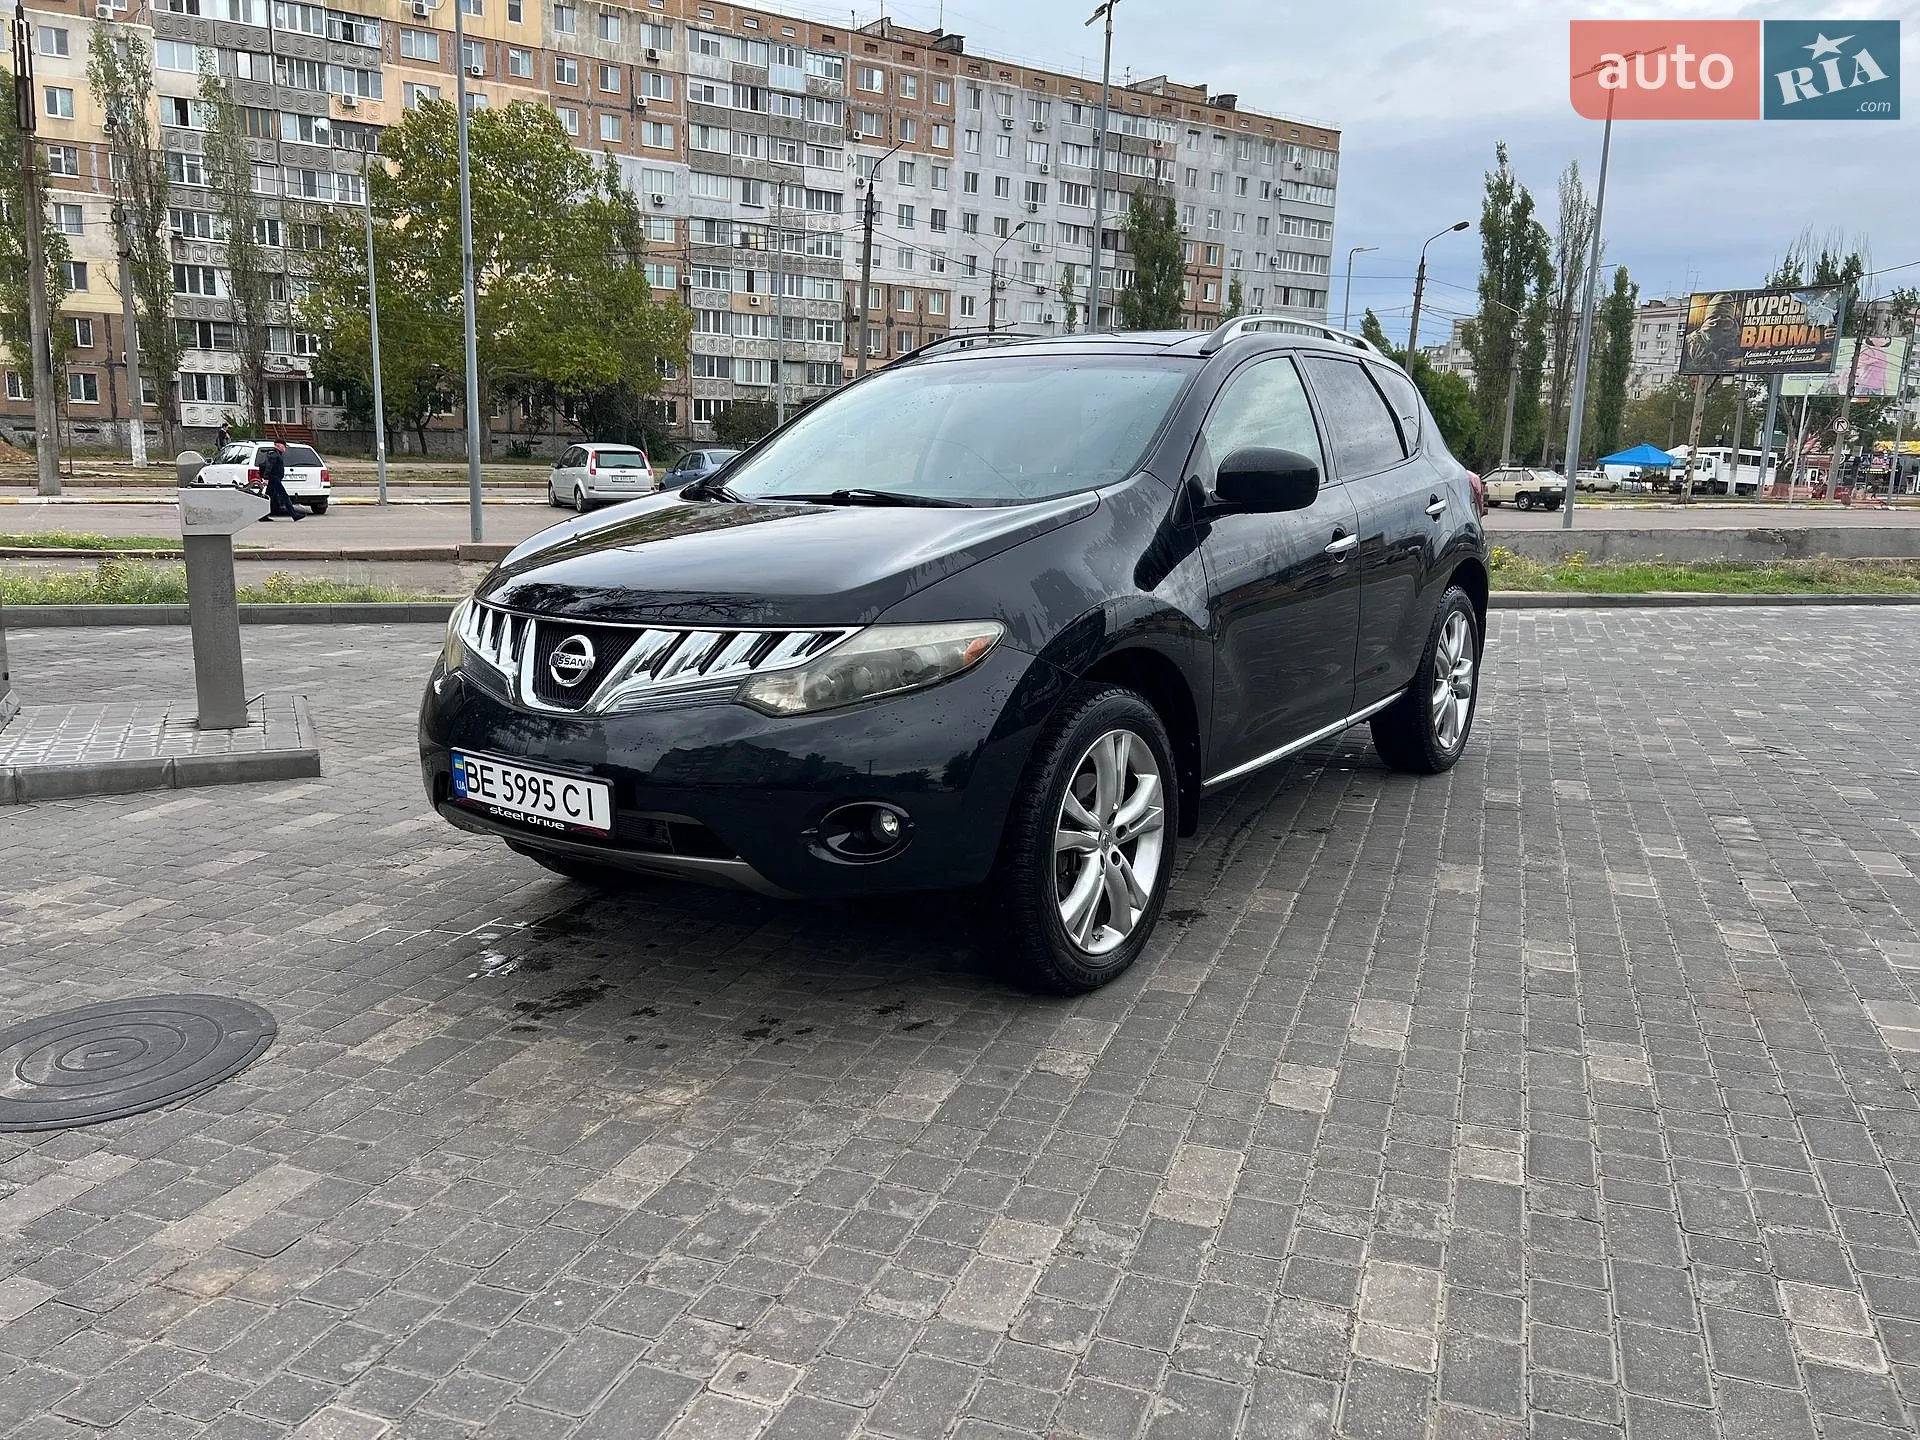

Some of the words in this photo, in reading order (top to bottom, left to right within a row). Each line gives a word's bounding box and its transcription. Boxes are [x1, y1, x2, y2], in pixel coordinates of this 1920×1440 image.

[1740, 325, 1820, 349] ВДОМА
[456, 779, 467, 791] UA
[464, 759, 497, 799] BE
[501, 770, 556, 812] 5995
[562, 784, 594, 821] CI
[489, 805, 525, 821] steel
[527, 814, 566, 831] drive
